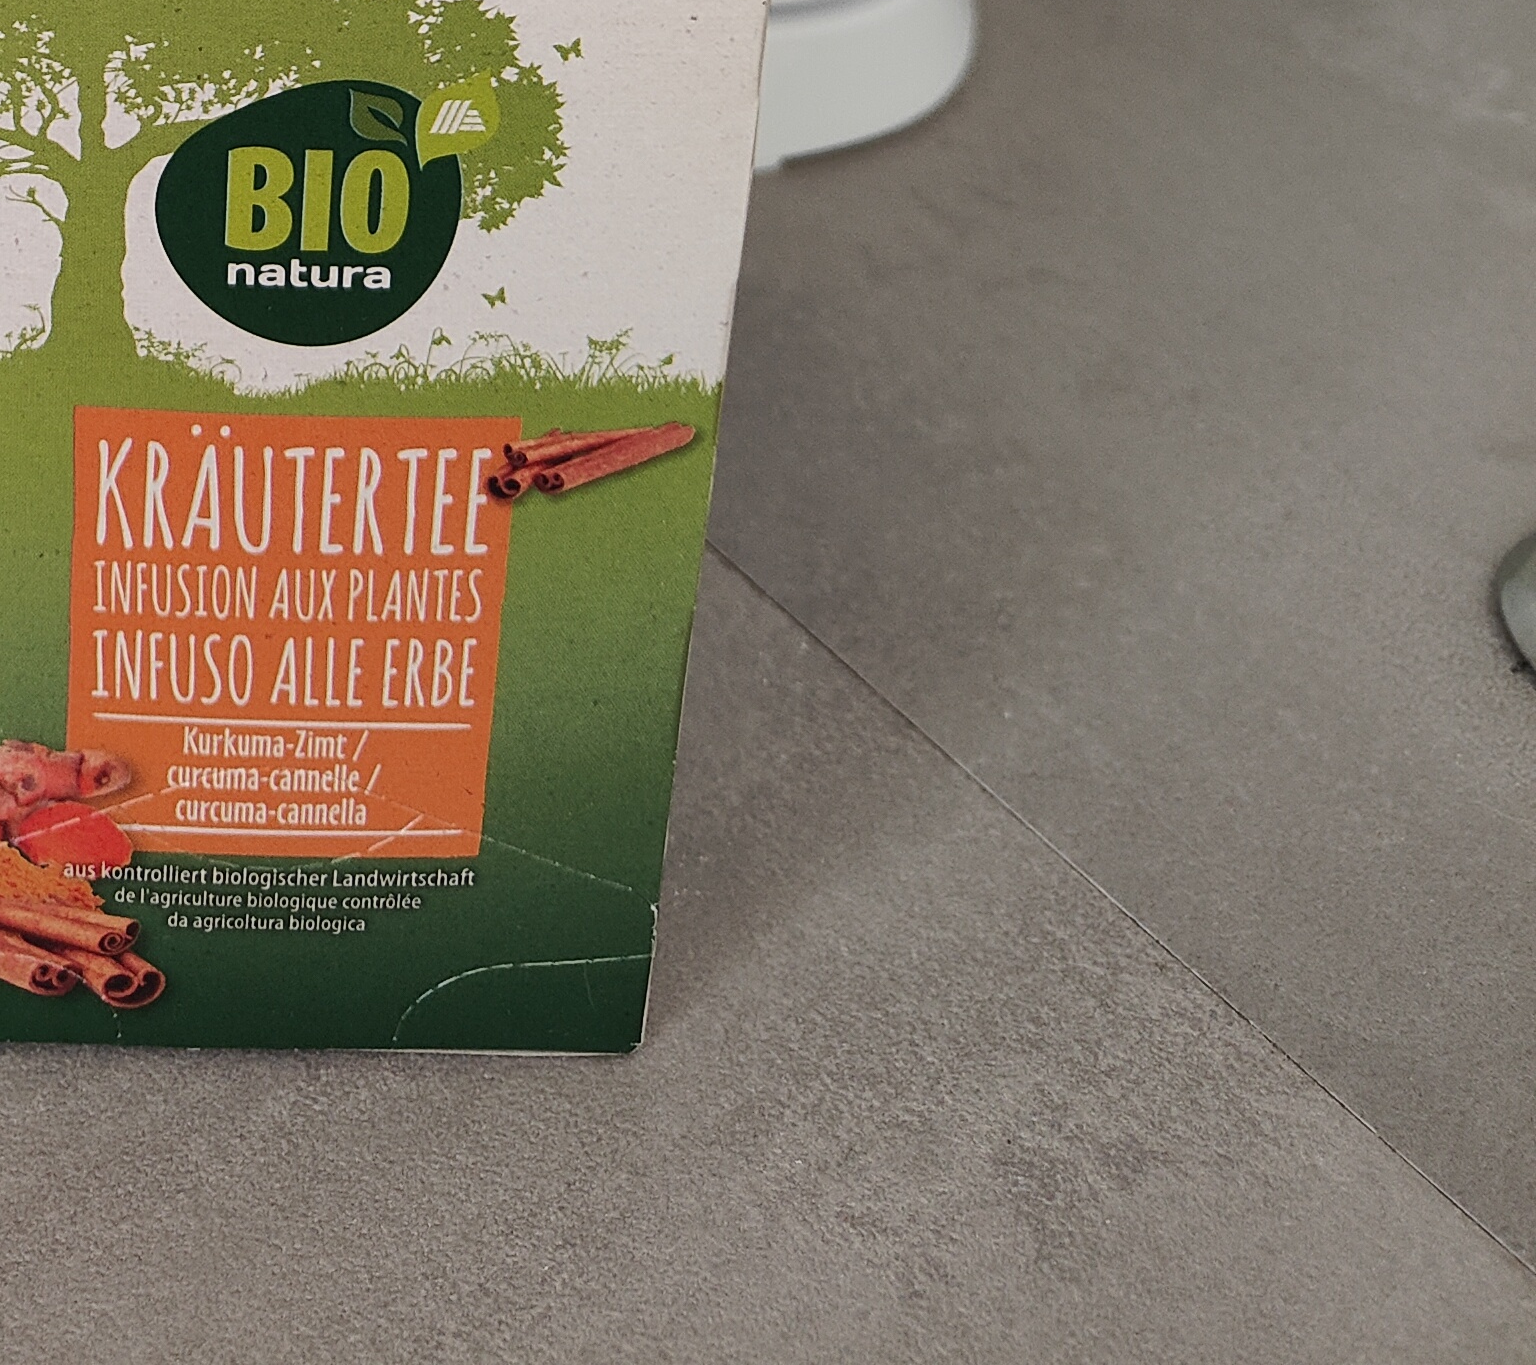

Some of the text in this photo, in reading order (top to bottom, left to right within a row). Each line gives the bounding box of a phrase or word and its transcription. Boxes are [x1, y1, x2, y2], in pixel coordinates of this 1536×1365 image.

[225, 146, 410, 254] BIO
[227, 258, 392, 290] natura
[96, 424, 492, 556] KRÄUTERTEE
[93, 560, 484, 623] INFUSION AUX PLANTES
[91, 630, 478, 708] INFUSO ALLE ERBE
[183, 726, 346, 760] Kurkuma-Zimt
[167, 764, 360, 792] curcuma-cannelle
[176, 798, 367, 826] curcuma-cannella
[64, 862, 475, 890] aus kontrolliert biologischer Landwirtschaft
[114, 886, 422, 912] de l'agriculture biologique contrôlée
[167, 911, 365, 935] da agricoltura biologica
